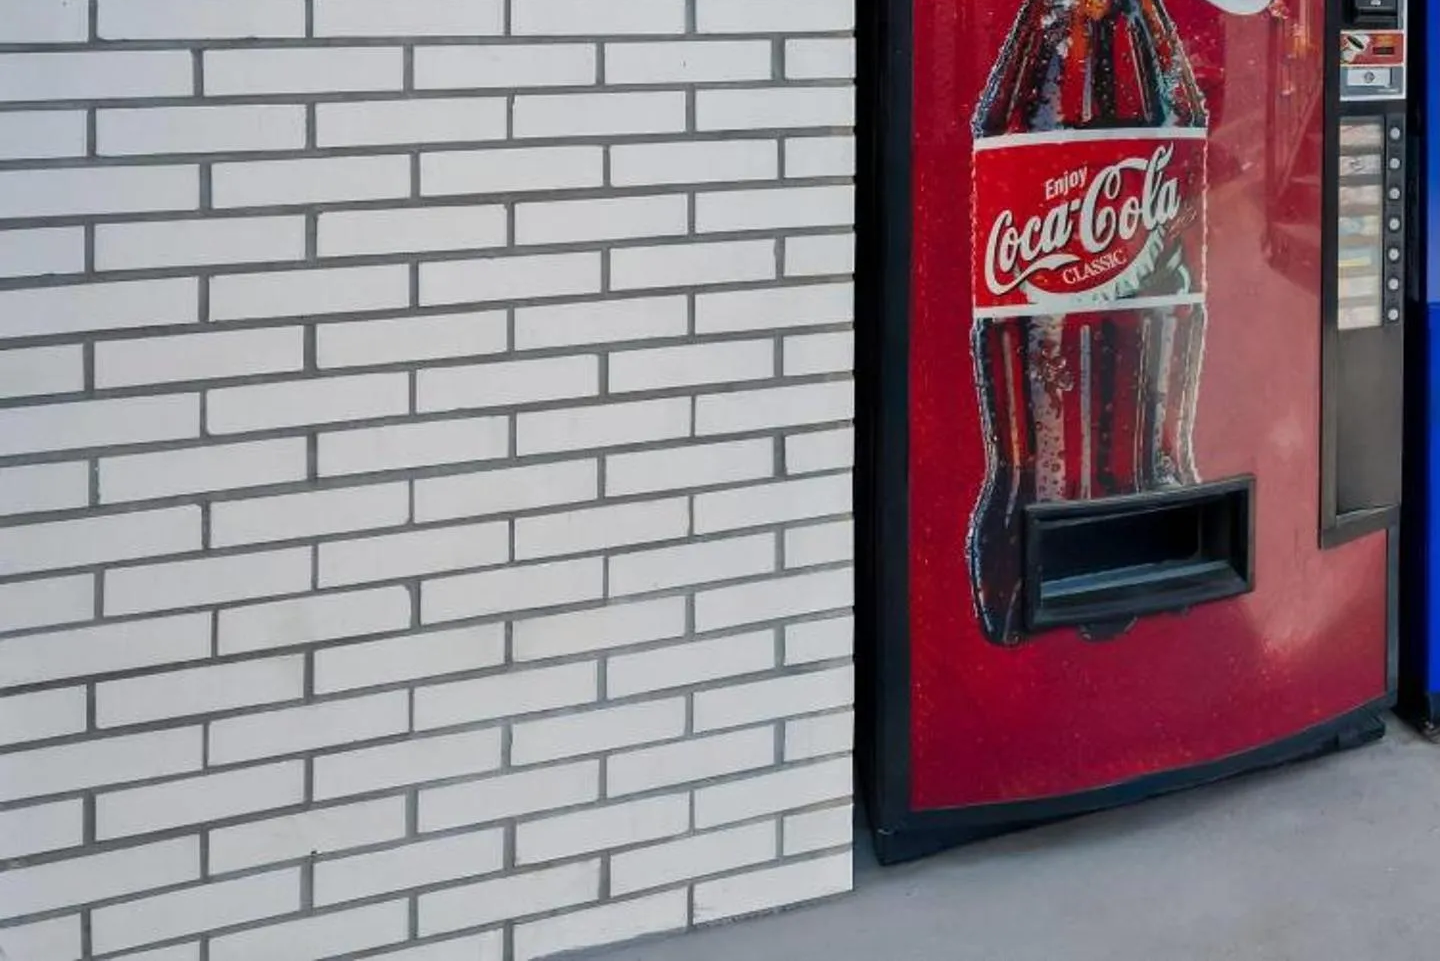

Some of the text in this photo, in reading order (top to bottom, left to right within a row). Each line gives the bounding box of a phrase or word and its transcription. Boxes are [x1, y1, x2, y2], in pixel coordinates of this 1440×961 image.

[1044, 165, 1088, 200] Enjoy
[984, 141, 1182, 296] Coca-Cola
[1062, 248, 1128, 285] CLASSIC
